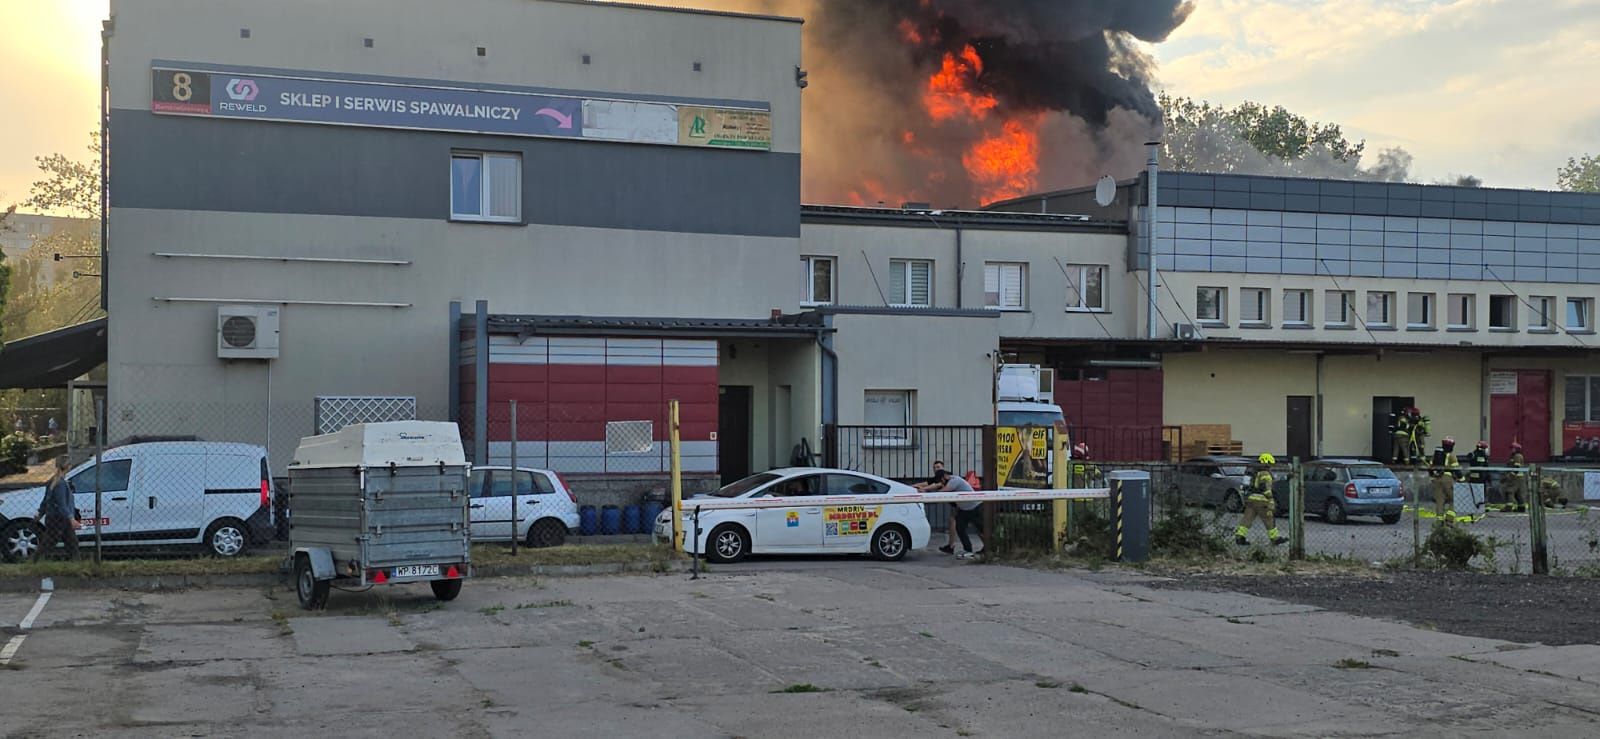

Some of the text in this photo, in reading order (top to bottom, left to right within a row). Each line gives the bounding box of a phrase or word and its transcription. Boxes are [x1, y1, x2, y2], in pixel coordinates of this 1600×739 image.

[173, 72, 193, 101] 8
[219, 102, 267, 113] REWELD
[280, 92, 521, 121] SKLEP I SERWIS SPAWALNICZY
[1033, 447, 1045, 457] TAXI
[398, 566, 409, 575] WP
